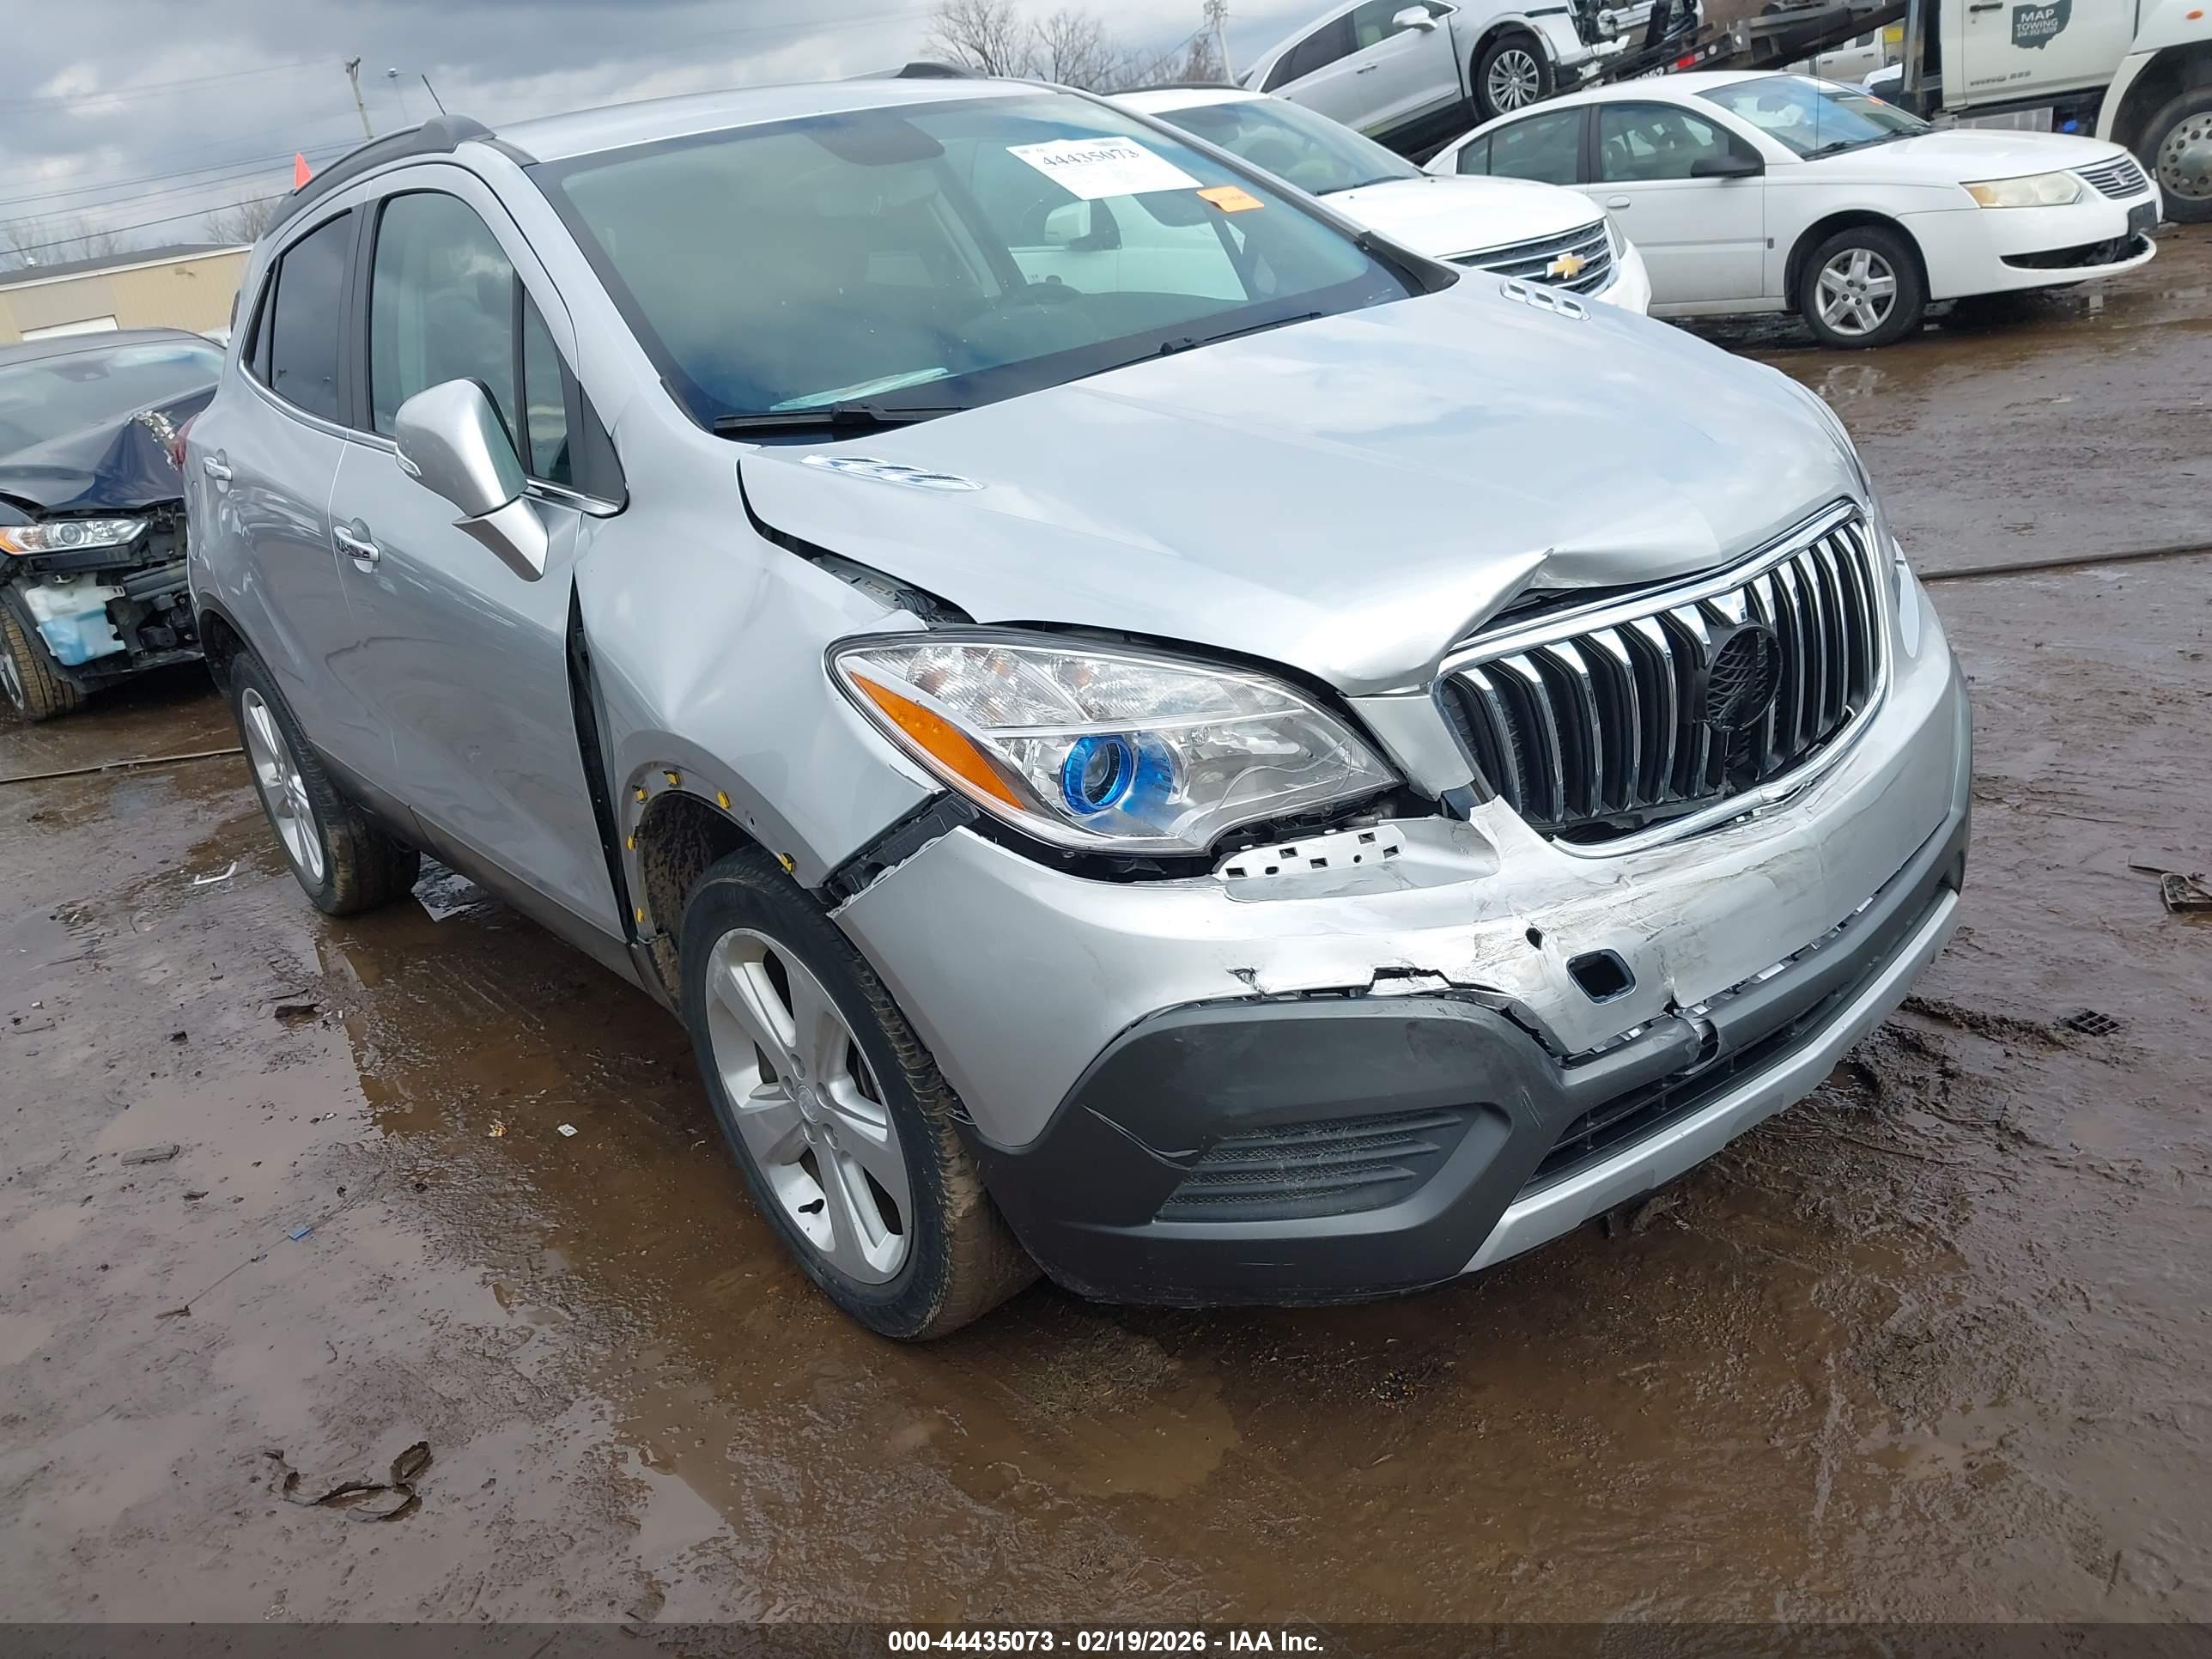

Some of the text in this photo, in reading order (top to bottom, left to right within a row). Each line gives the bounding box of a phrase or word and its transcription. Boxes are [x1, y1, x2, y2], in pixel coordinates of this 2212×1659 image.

[2021, 9, 2055, 23] MAP
[2016, 17, 2059, 32] TOWING
[1042, 149, 1140, 167] 44435073
